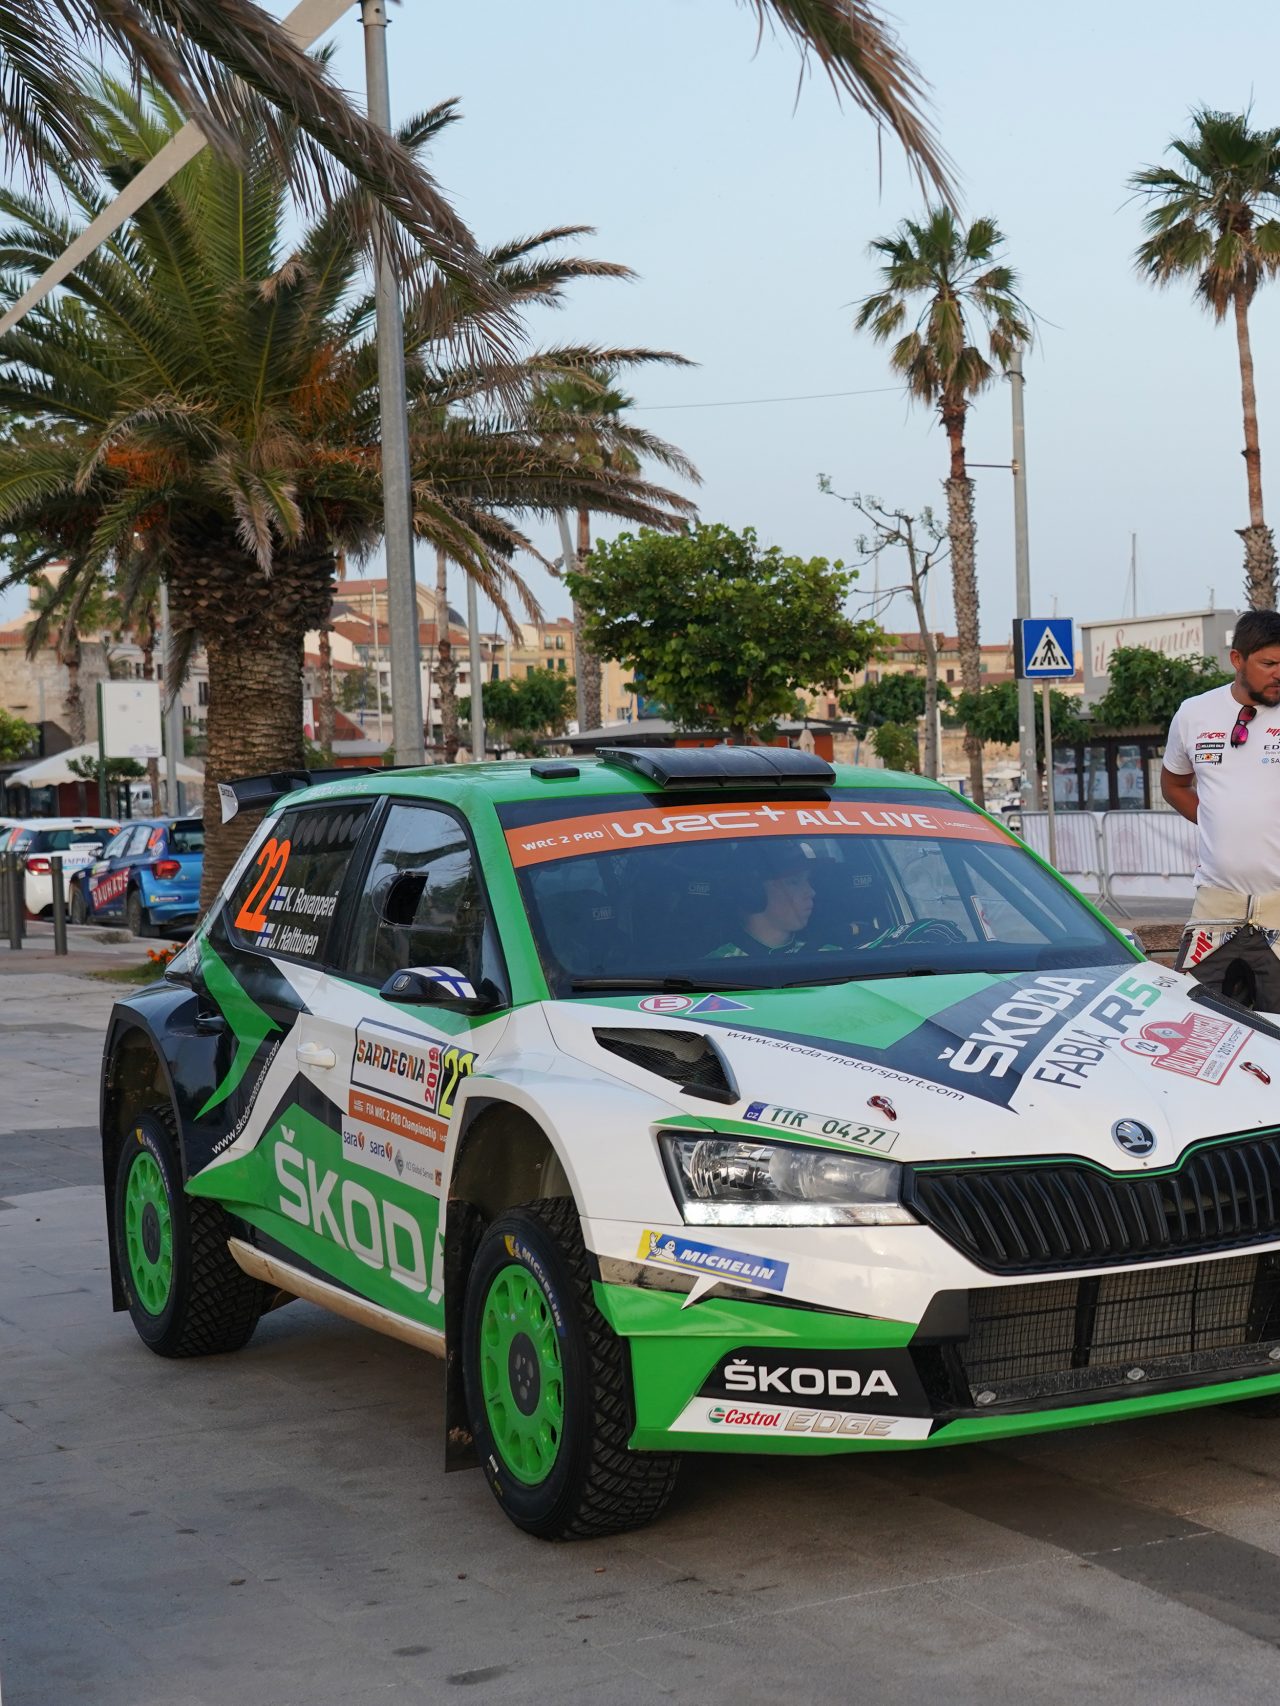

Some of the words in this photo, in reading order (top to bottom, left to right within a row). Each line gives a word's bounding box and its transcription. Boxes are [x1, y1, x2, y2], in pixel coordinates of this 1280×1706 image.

[796, 810, 862, 826] ALL
[861, 811, 938, 829] LIVE
[521, 838, 558, 851] WRC
[560, 836, 571, 844] 2
[573, 830, 604, 842] PRO
[92, 870, 130, 907] BAUHAUS
[235, 838, 291, 932] 22
[276, 927, 319, 956] Halttunen
[937, 976, 1097, 1079] ŠKODA
[1032, 1029, 1121, 1090] FABIA
[1089, 976, 1162, 1035] R5
[356, 1039, 425, 1083] SARDEGNA
[424, 1047, 440, 1104] 2019
[726, 1030, 965, 1101] www.skoda-motorsport.com
[366, 1102, 374, 1115] FIA
[374, 1106, 386, 1121] WRC
[386, 1110, 391, 1123] 2
[391, 1112, 401, 1128] PRO
[402, 1117, 437, 1141] Championship
[746, 1111, 760, 1120] CZ
[770, 1108, 809, 1127] 11R
[821, 1119, 887, 1146] 0427
[343, 1130, 358, 1146] sara
[370, 1139, 386, 1158] sara
[680, 1248, 776, 1281] MICHELIN
[723, 1358, 899, 1397] ŠKODA
[724, 1408, 782, 1428] Castrol
[783, 1410, 900, 1437] EDGE
